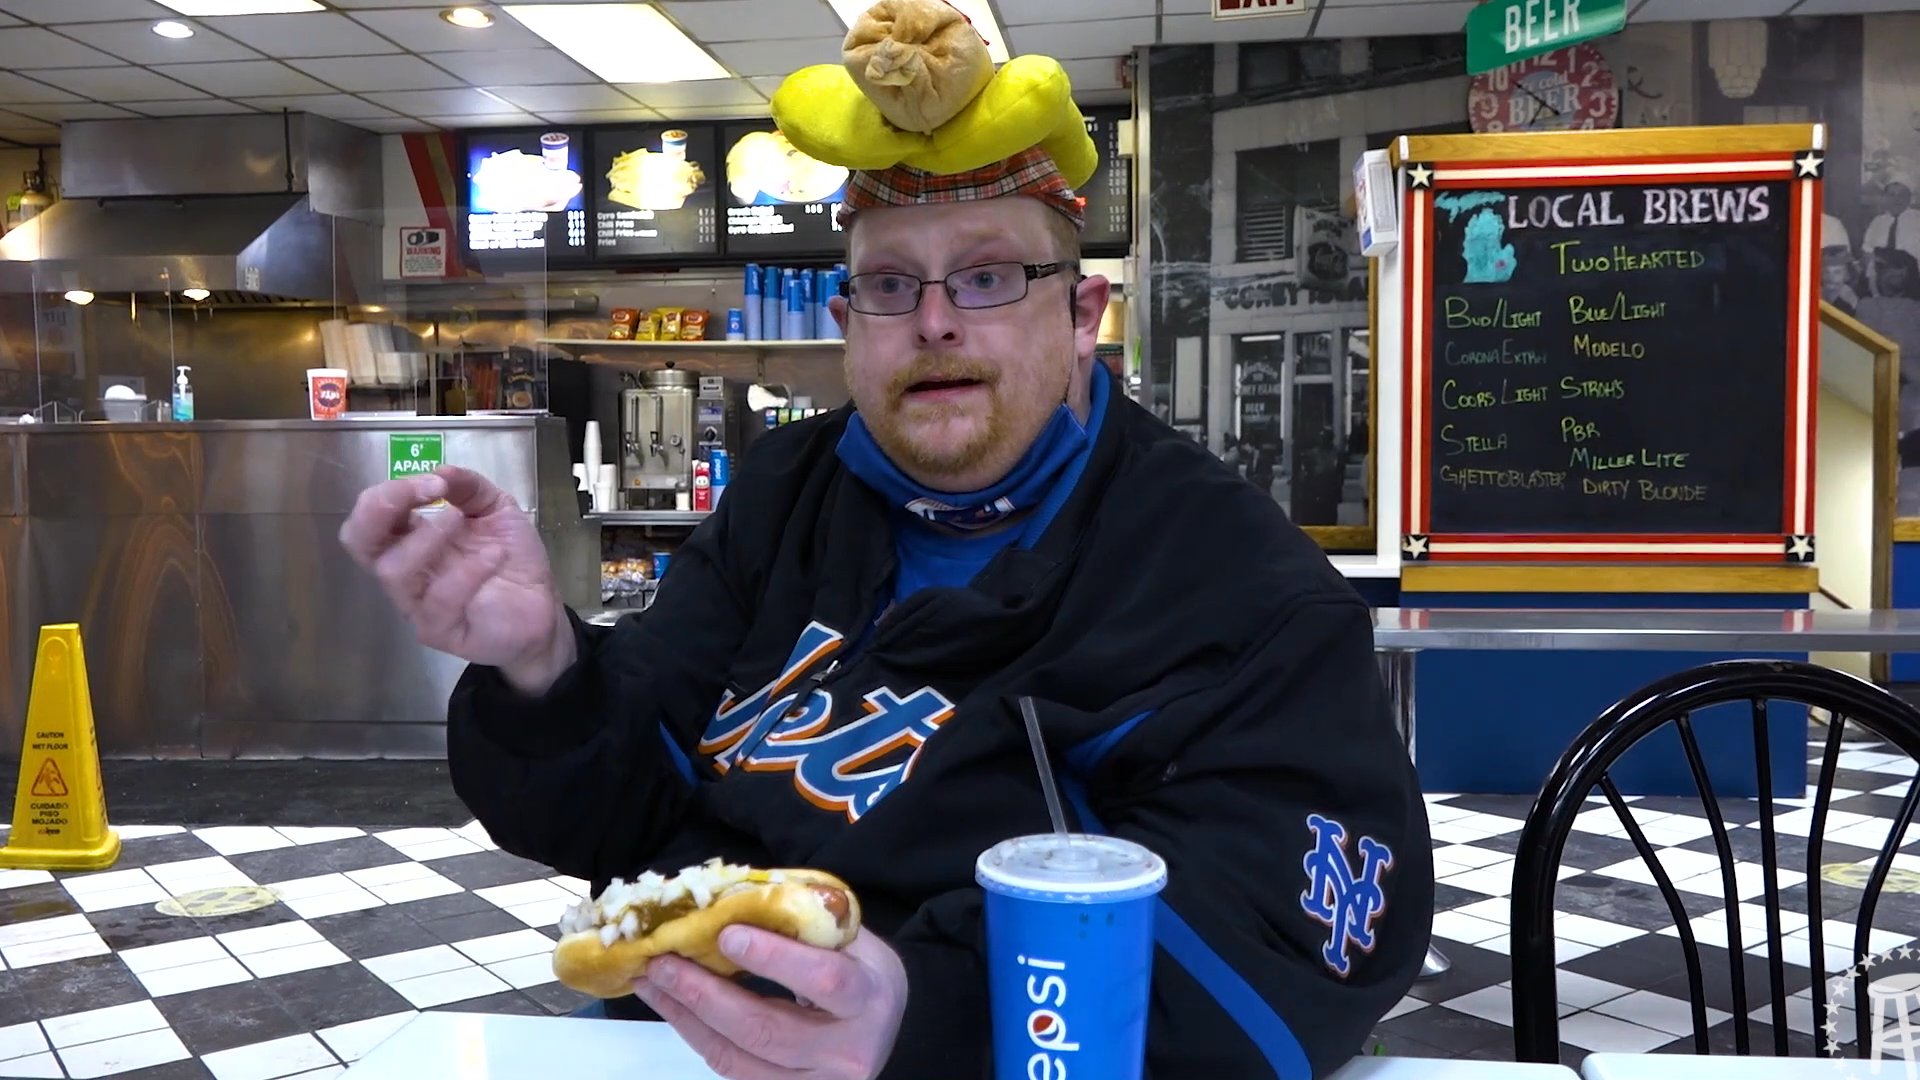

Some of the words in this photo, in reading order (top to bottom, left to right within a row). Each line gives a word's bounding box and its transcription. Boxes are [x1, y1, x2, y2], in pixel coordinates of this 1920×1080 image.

[1505, 0, 1580, 53] BEER
[1488, 68, 1508, 91] 10
[1581, 62, 1599, 87] 2
[1481, 93, 1499, 119] 9
[1509, 83, 1581, 126] BEER
[1589, 91, 1607, 117] 3
[1508, 191, 1625, 229] LOCAL
[1643, 186, 1769, 224] BREWS
[406, 247, 441, 255] WARNING
[1225, 282, 1300, 309] CONEY
[410, 443, 424, 457] 6'
[393, 460, 439, 473] APART
[36, 731, 64, 739] CAUTION
[697, 620, 956, 824] et
[30, 802, 69, 810] CUIDADO
[1300, 814, 1393, 978] NY
